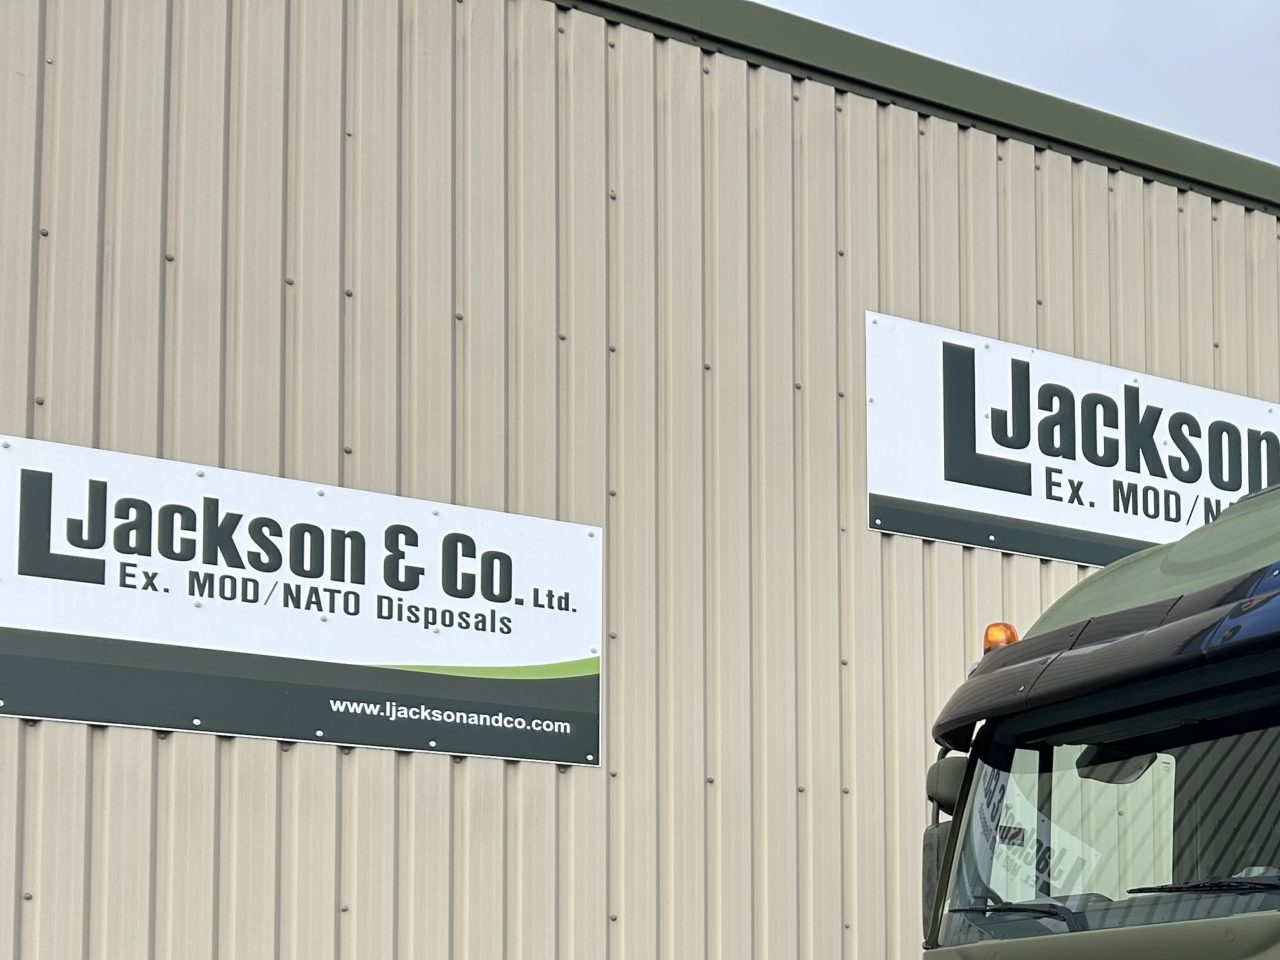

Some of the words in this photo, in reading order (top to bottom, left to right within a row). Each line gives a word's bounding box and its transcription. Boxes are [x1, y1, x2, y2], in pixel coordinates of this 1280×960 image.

[1045, 465, 1096, 508] Ex.
[1112, 478, 1238, 525] MOD/N
[118, 561, 170, 594] Ex.
[187, 569, 361, 617] MOD/NATO
[376, 594, 513, 635] Disposals
[383, 523, 425, 592] &
[441, 531, 525, 606] Co.
[533, 587, 577, 613] Ltd.
[329, 699, 571, 734] www.ljacksonandco.com
